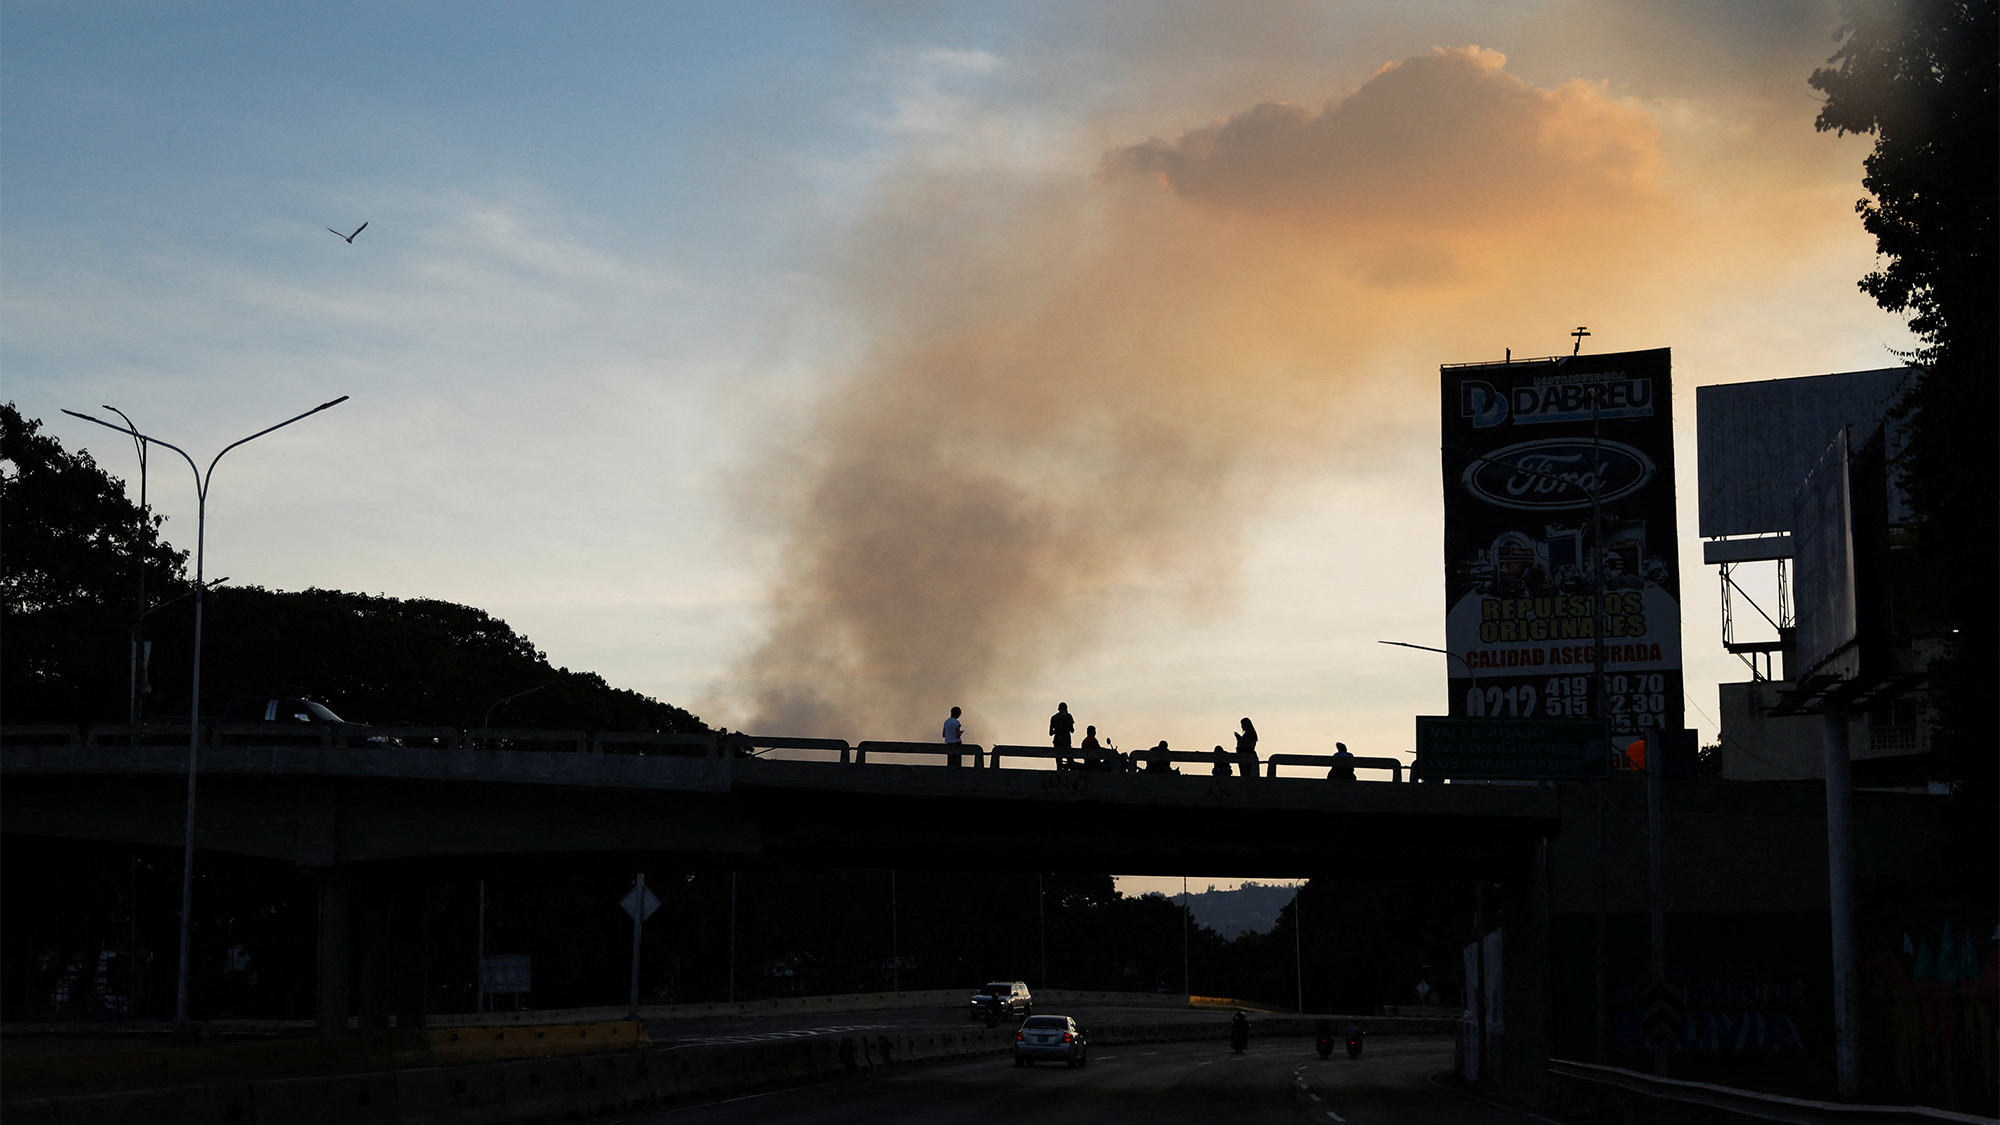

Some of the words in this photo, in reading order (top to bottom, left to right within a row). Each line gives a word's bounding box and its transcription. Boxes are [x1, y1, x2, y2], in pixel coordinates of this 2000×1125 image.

[1533, 371, 1627, 386] DISTRIBUIDORA
[1506, 453, 1608, 496] Ford
[1482, 592, 1643, 620] REPUESTOS
[1480, 614, 1646, 643] ORIGINALES
[1466, 649, 1545, 669] CALIDAD
[1545, 676, 1588, 697] 419
[1466, 684, 1538, 718] 0212
[1545, 696, 1588, 717] 515
[1430, 727, 1482, 738] VALLE
[1488, 728, 1545, 739] ABAJO
[1459, 743, 1492, 754] LOS
[1497, 743, 1579, 755] ILUSTRES
[1429, 758, 1459, 769] LOS
[1463, 758, 1581, 771] CHAGUARAMOS
[1615, 1008, 1806, 1056] BLIVIA
